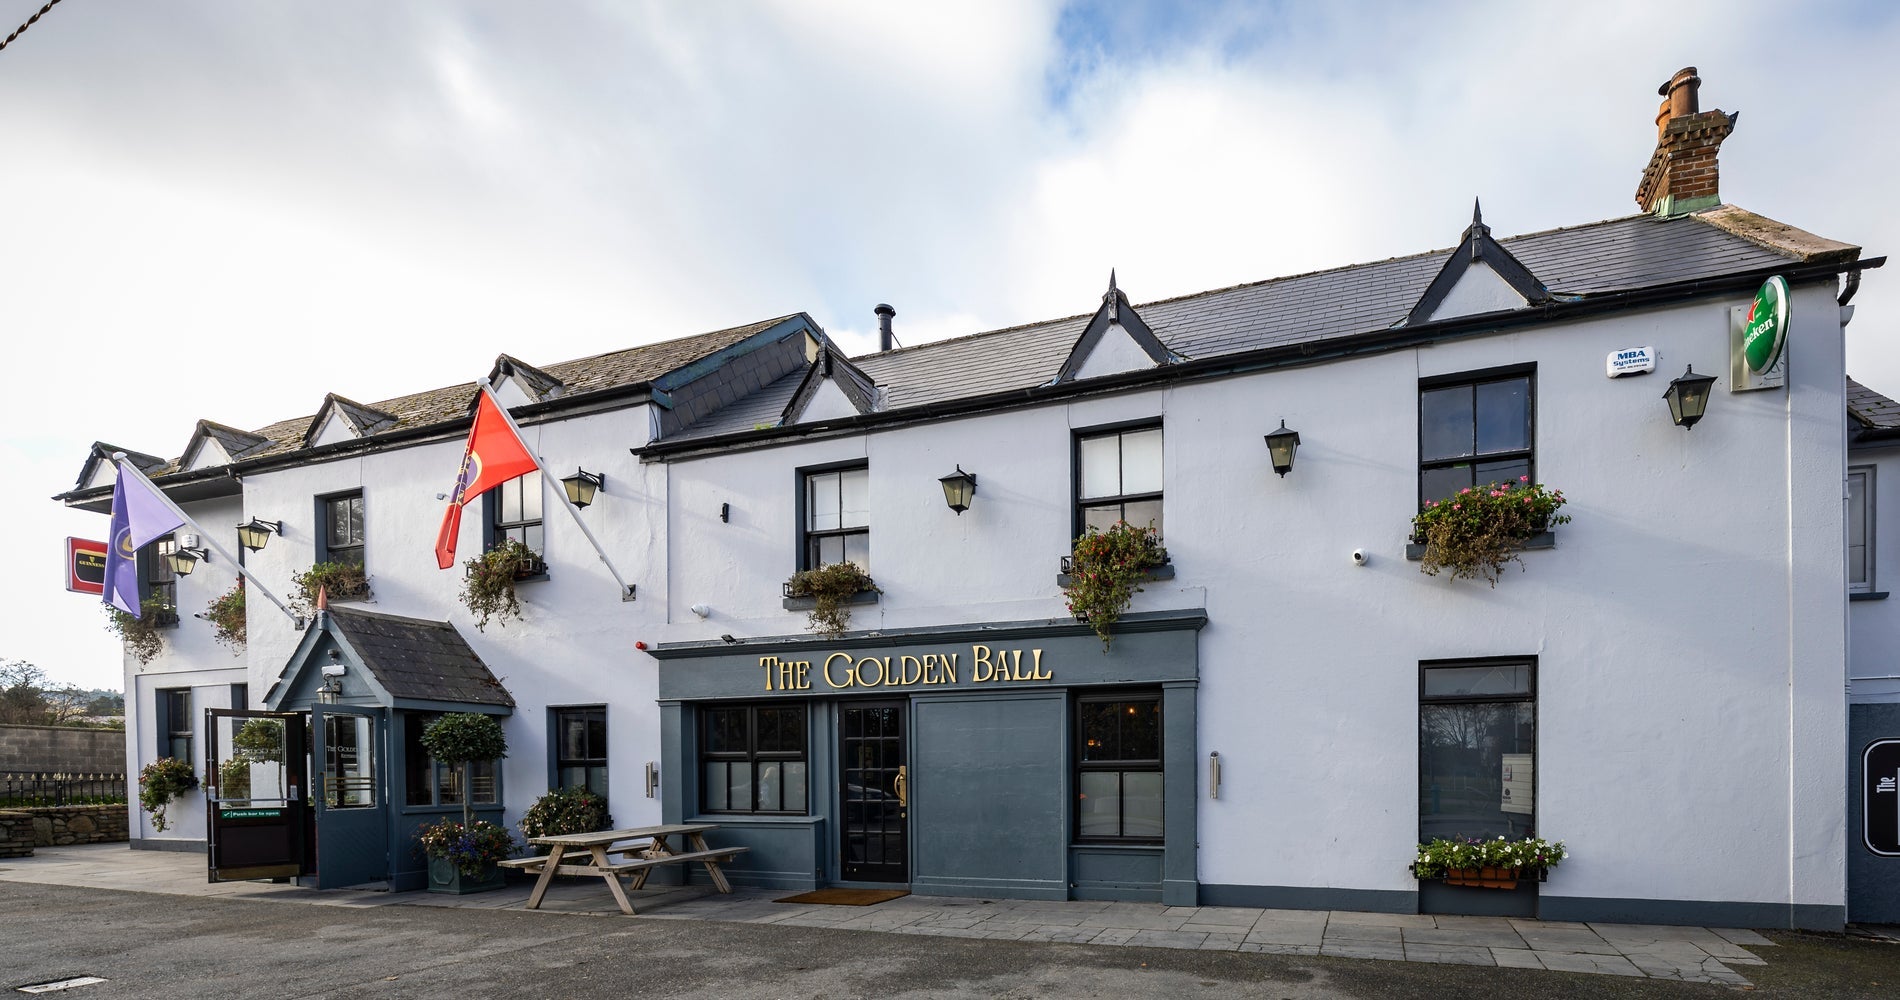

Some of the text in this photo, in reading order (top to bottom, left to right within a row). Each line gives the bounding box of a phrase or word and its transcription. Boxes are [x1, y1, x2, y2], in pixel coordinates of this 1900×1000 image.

[1617, 350, 1646, 360] MBA
[1613, 357, 1650, 366] Systems
[79, 560, 105, 568] GUINNESS
[759, 645, 1053, 690] THE GOLDEN BALL
[1876, 776, 1896, 793] The
